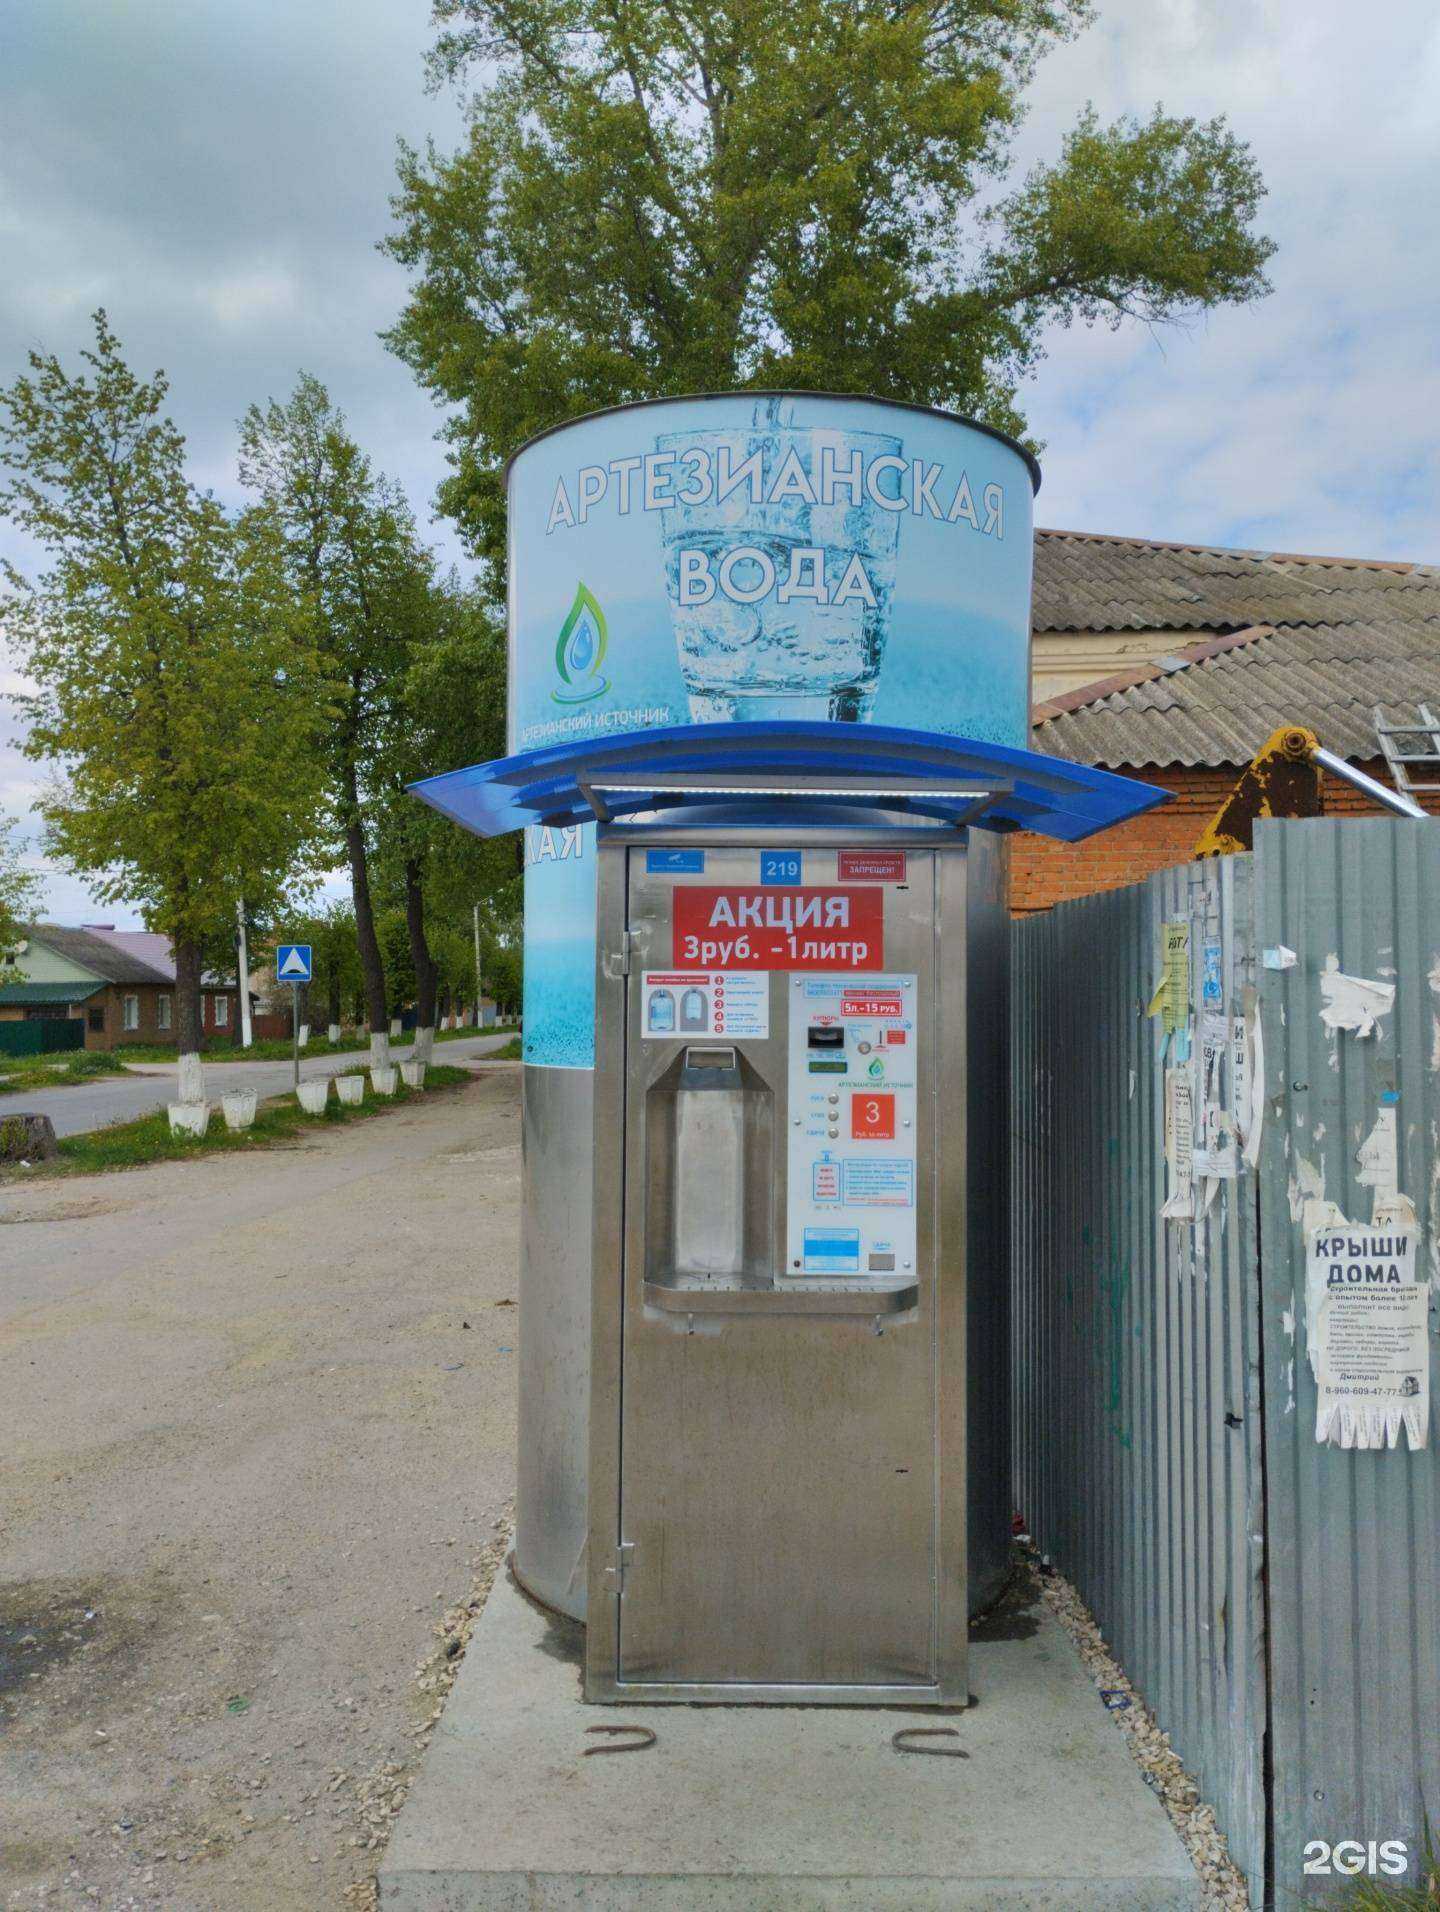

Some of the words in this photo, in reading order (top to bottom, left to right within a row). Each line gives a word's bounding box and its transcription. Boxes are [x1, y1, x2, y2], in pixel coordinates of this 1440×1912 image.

[545, 446, 1005, 540] АРТЕЗИАНСКАЯ
[678, 546, 879, 606] ВОДА
[521, 711, 593, 738] РТЕЗИАНСКИЙ
[594, 706, 670, 728] ИСТОЧНИК
[766, 861, 798, 876] 219
[708, 896, 850, 935] АКЦИЯ
[683, 934, 760, 965] 3руб.
[865, 1101, 880, 1124] 3
[1316, 1236, 1408, 1258] КРЫШИ
[1327, 1264, 1401, 1288] ДОМА
[1339, 1372, 1380, 1381] Дмитрий
